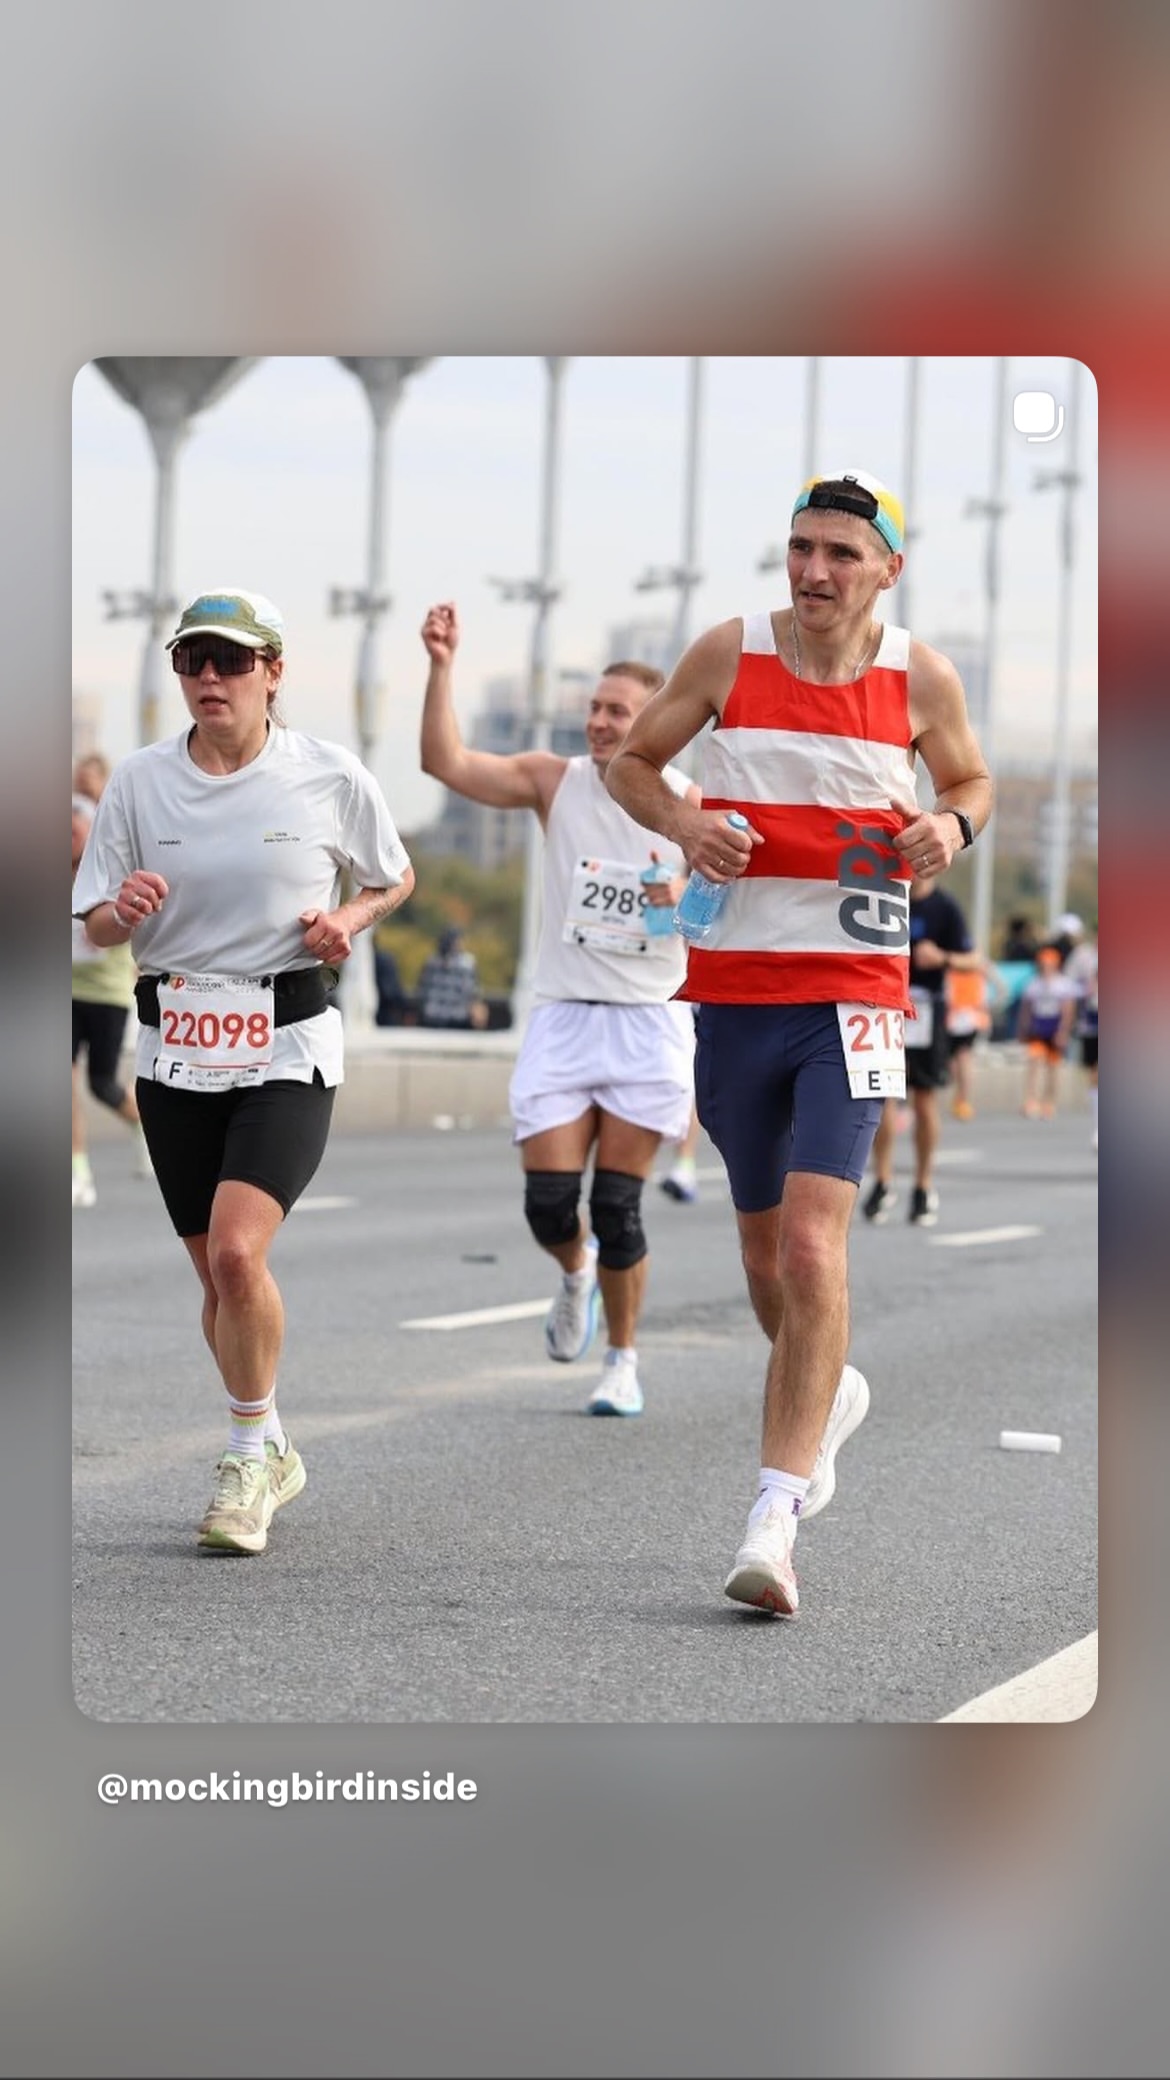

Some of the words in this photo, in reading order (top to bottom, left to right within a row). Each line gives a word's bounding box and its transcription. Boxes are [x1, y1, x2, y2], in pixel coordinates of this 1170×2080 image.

[163, 1010, 269, 1048] 22098
[169, 1062, 183, 1079] F
[868, 1070, 881, 1091] E
